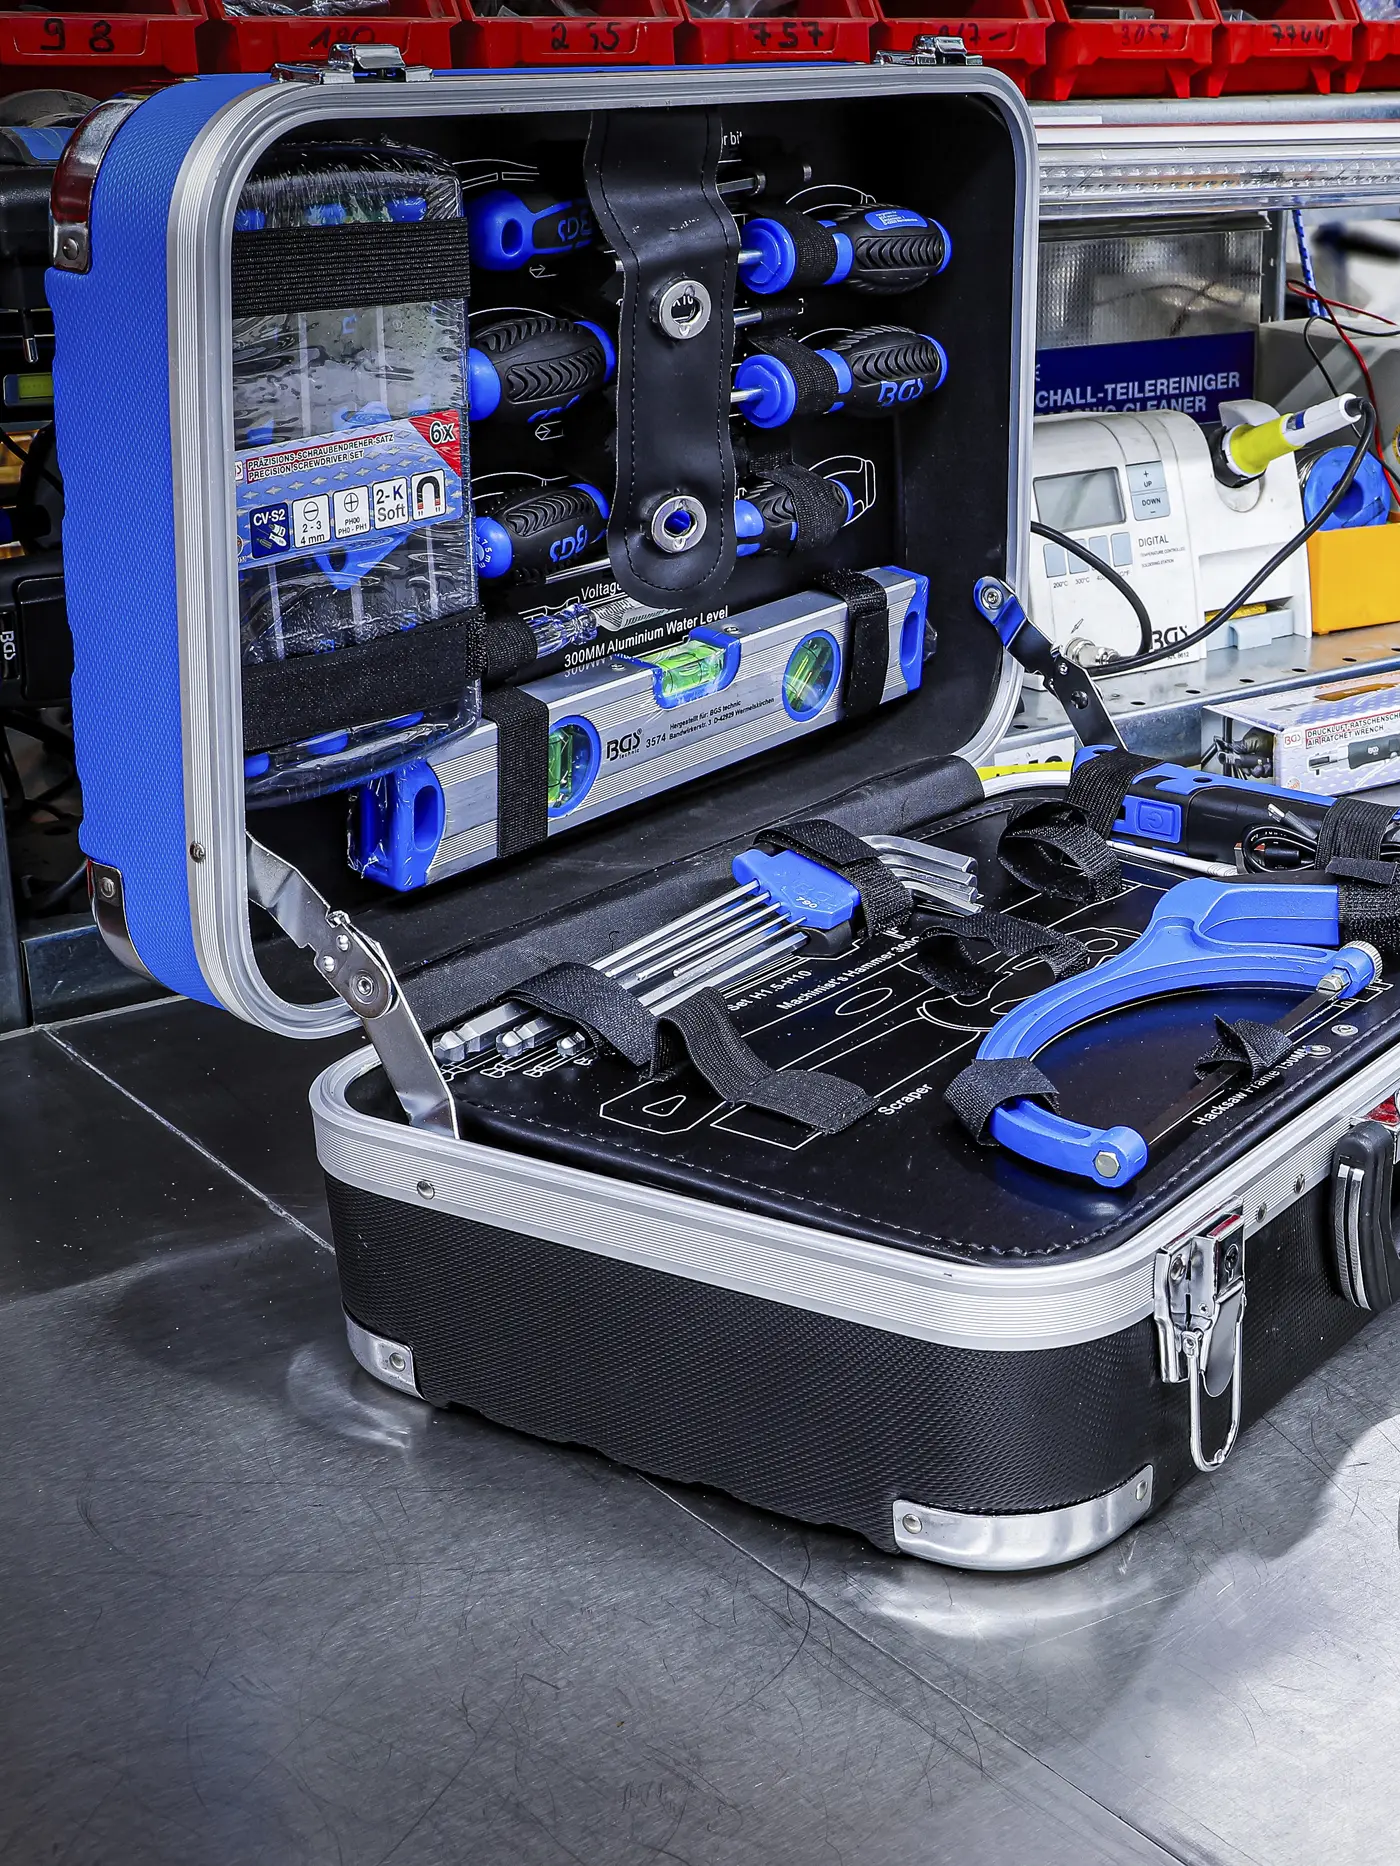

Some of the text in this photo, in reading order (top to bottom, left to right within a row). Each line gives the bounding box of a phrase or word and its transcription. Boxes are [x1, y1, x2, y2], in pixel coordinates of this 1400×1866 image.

[878, 378, 924, 407] BGS
[429, 420, 454, 445] 6x
[247, 432, 394, 470] PRÄZISIONS-SCHRAUBENDREHER-SATZ
[248, 449, 364, 481] PRECISION SCREWDRIVER SET
[1144, 480, 1153, 488] UP
[1141, 497, 1161, 507] DOWN
[253, 508, 286, 526] CV-S2
[344, 516, 361, 526] PH00
[376, 505, 406, 523] Soft
[308, 534, 325, 545] mm
[337, 526, 350, 535] PH0
[354, 523, 368, 533] PH1
[1138, 534, 1169, 548] DIGITAL
[564, 642, 606, 668] 300MM
[607, 628, 664, 655] Aluminium
[666, 617, 698, 636] Water
[699, 604, 729, 625] Level
[669, 714, 699, 730] Hergestellt
[709, 706, 722, 717] BGS
[722, 700, 741, 711] technic
[669, 722, 707, 740] Bandwirkerstr.
[713, 711, 735, 724] D-42929
[735, 697, 775, 716] Wermelskirchen
[606, 732, 642, 761] BGS
[645, 733, 666, 748] 3574
[1307, 724, 1384, 747] AIR RATCHET WRENCH
[795, 896, 818, 909] 790
[776, 975, 850, 1011] Machinist's
[847, 952, 894, 978] Hammer
[727, 997, 752, 1012] Set
[877, 1083, 933, 1116] Scraper
[1192, 1090, 1248, 1126] Hacksaw
